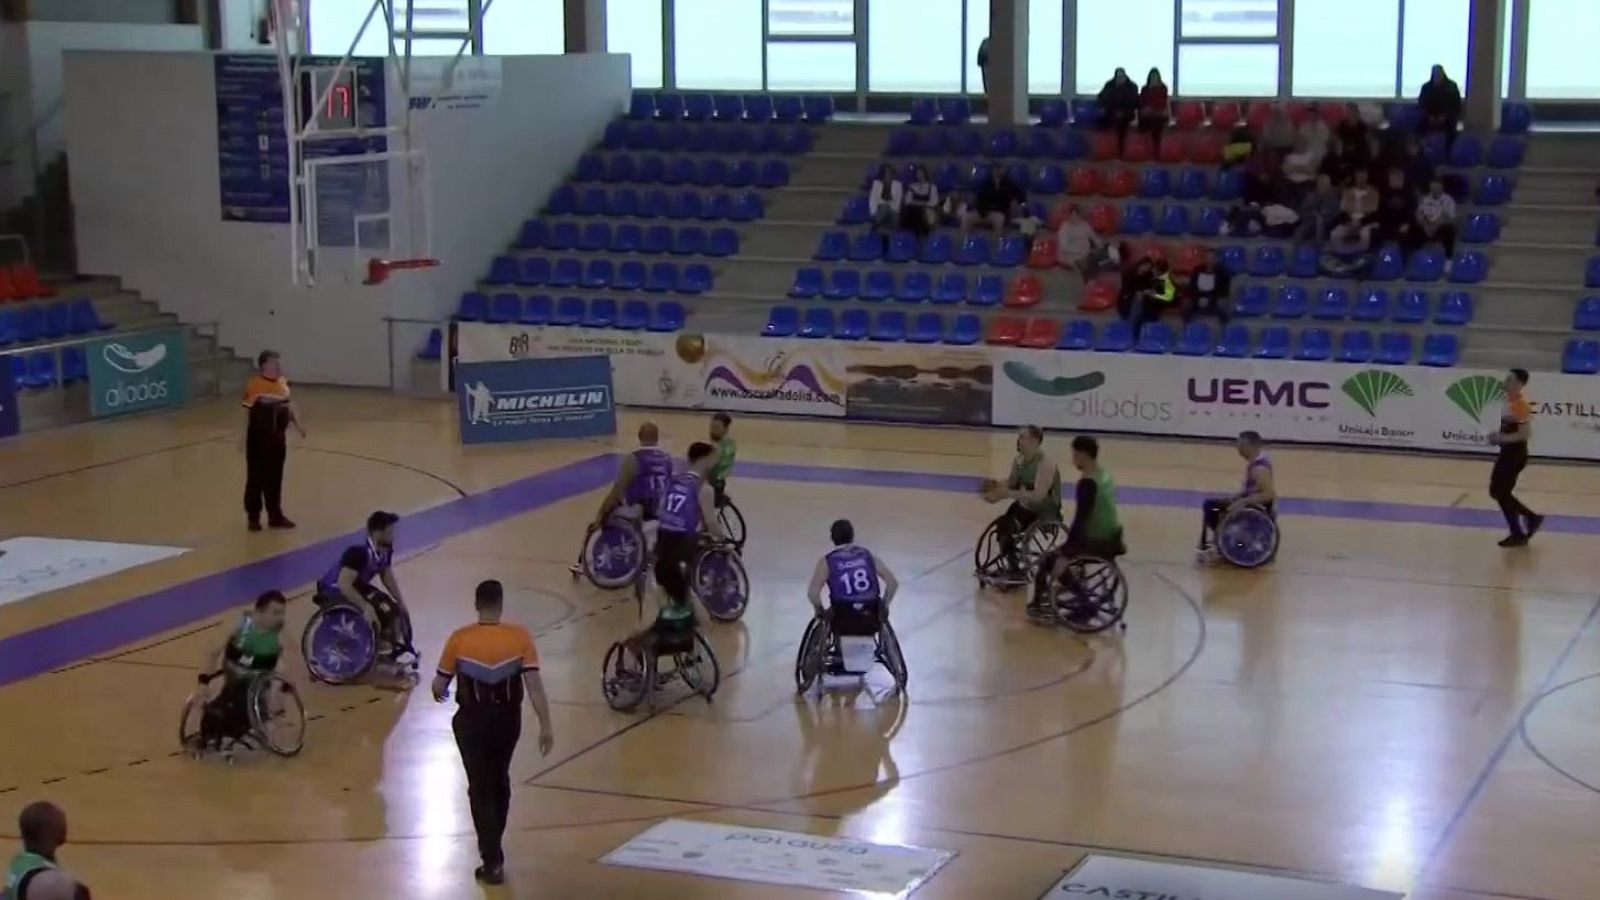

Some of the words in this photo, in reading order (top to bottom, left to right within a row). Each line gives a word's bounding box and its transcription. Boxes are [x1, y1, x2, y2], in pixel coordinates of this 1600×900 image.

[327, 86, 348, 119] 17
[497, 391, 603, 410] MICHELIN
[1187, 377, 1330, 409] UEMC
[666, 493, 687, 513] 17
[840, 568, 870, 595] 18
